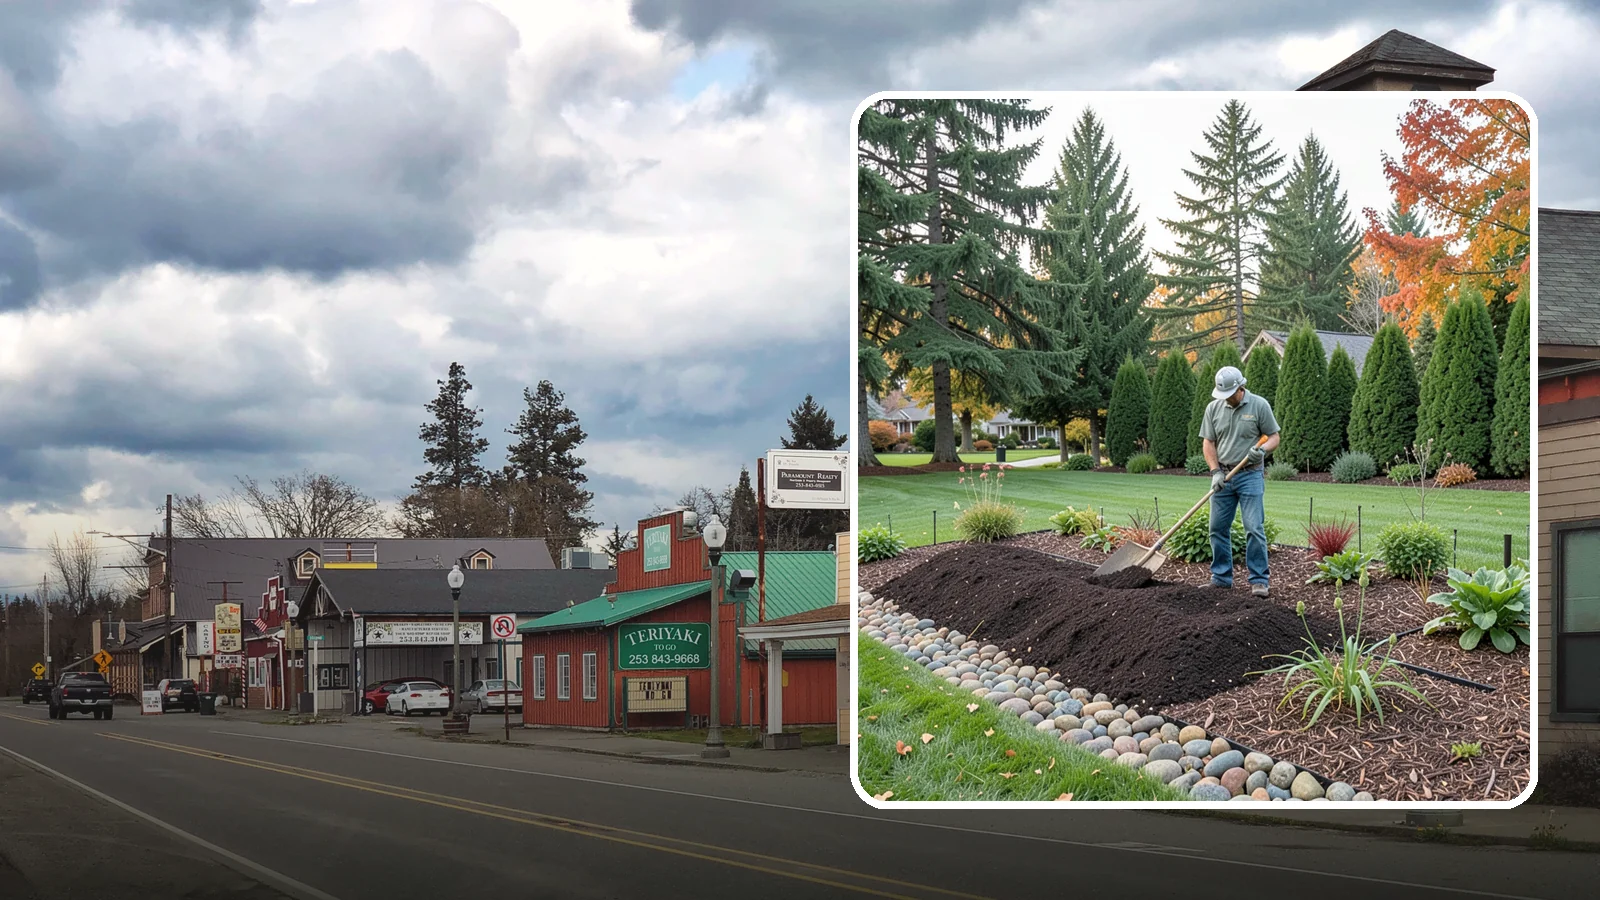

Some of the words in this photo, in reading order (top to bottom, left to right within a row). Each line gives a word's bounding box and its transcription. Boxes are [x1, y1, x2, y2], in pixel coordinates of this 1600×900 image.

[817, 472, 839, 480] REALTY
[625, 628, 702, 646] TERIYAKI
[629, 654, 648, 664] 253
[652, 654, 700, 664] 843-9668
